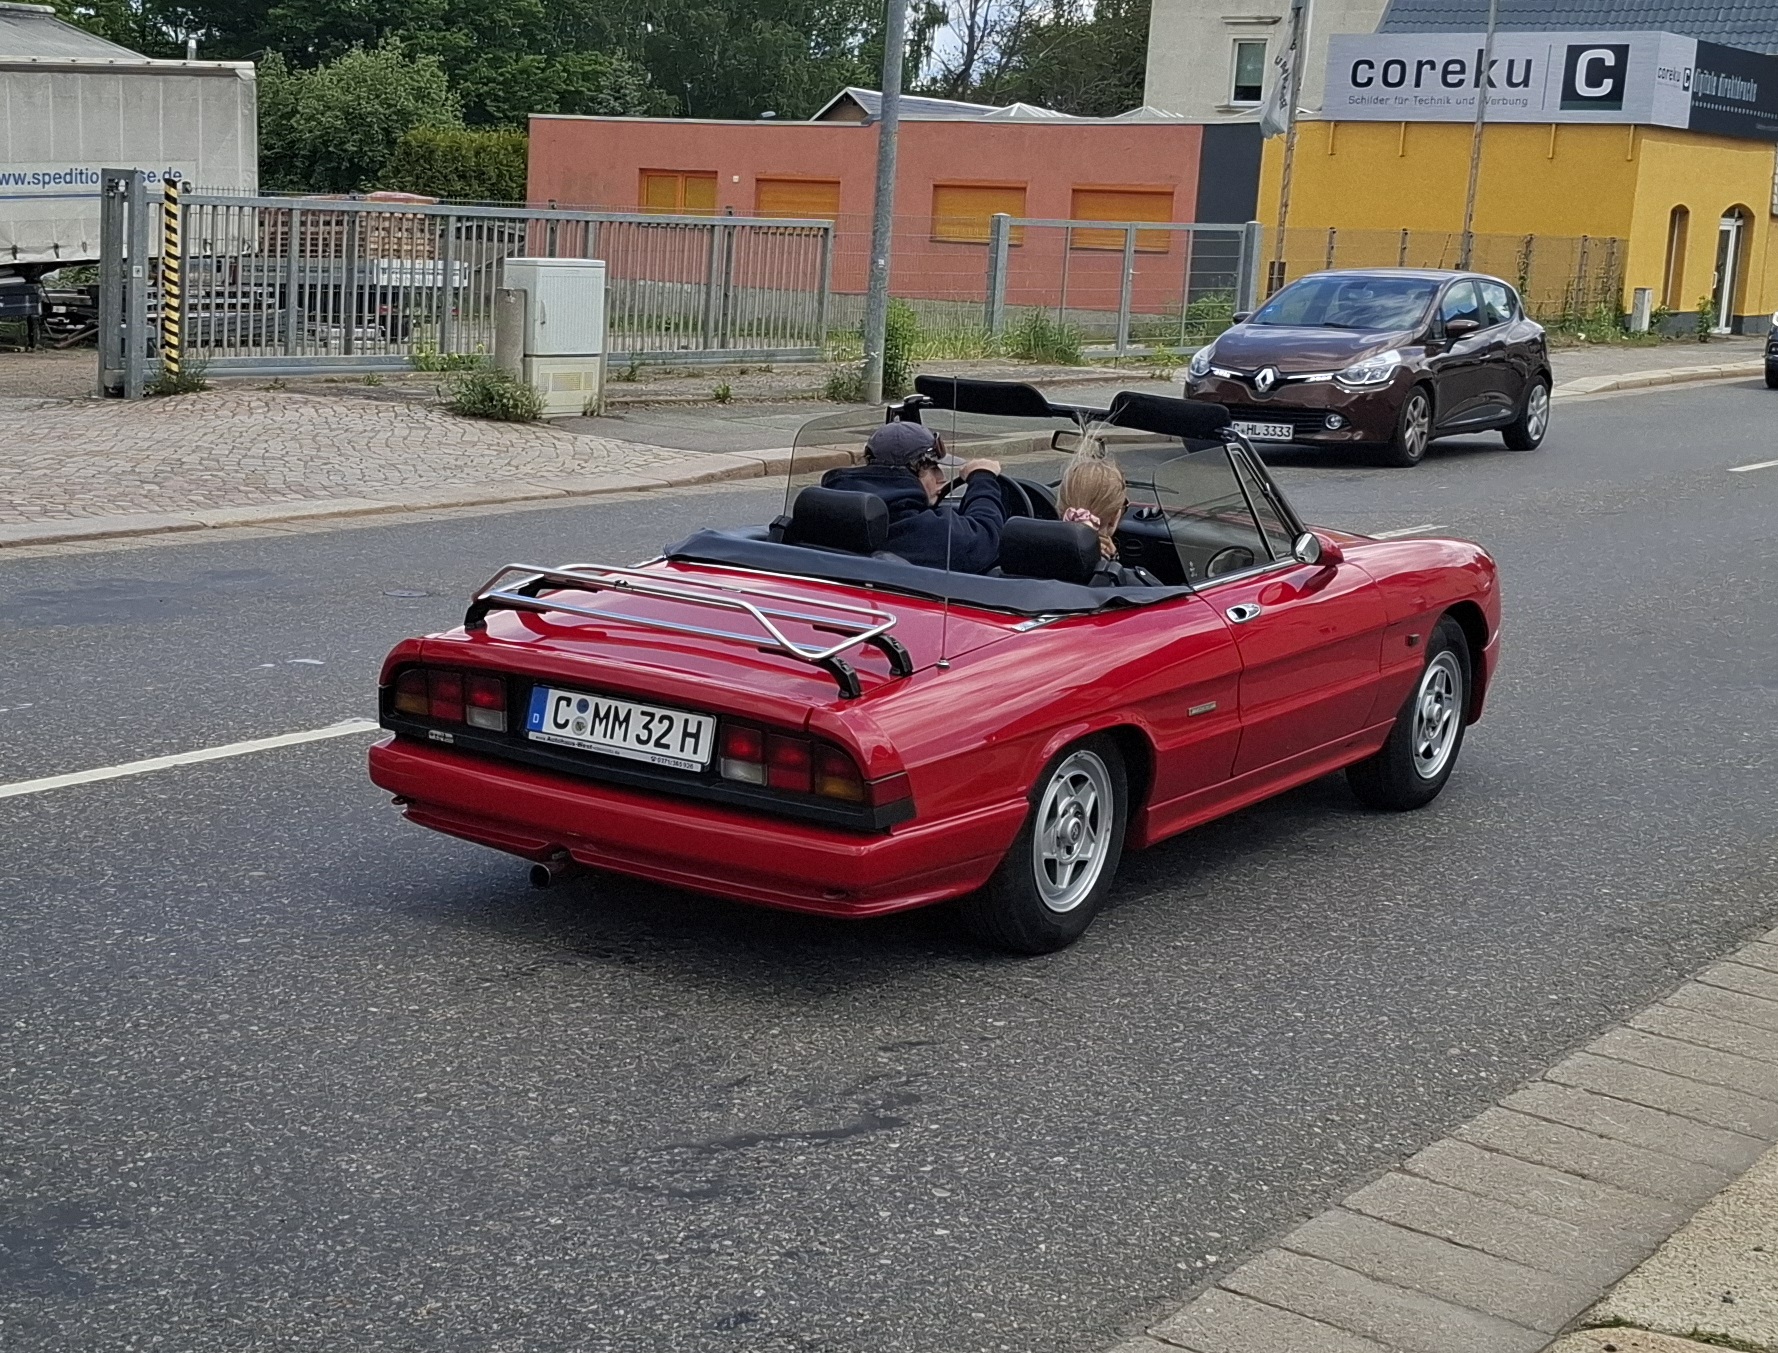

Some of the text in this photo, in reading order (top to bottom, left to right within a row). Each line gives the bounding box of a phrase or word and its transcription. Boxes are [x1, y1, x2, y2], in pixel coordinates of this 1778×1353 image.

[1351, 48, 1533, 89] coreku
[1574, 49, 1616, 97] C
[1348, 95, 1391, 105] Schilder
[1394, 95, 1409, 105] für
[1413, 95, 1451, 105] Technik
[1455, 96, 1476, 106] und
[1246, 423, 1261, 436] HL
[1262, 424, 1292, 438] 3333
[532, 713, 540, 724] D
[552, 695, 573, 730] C
